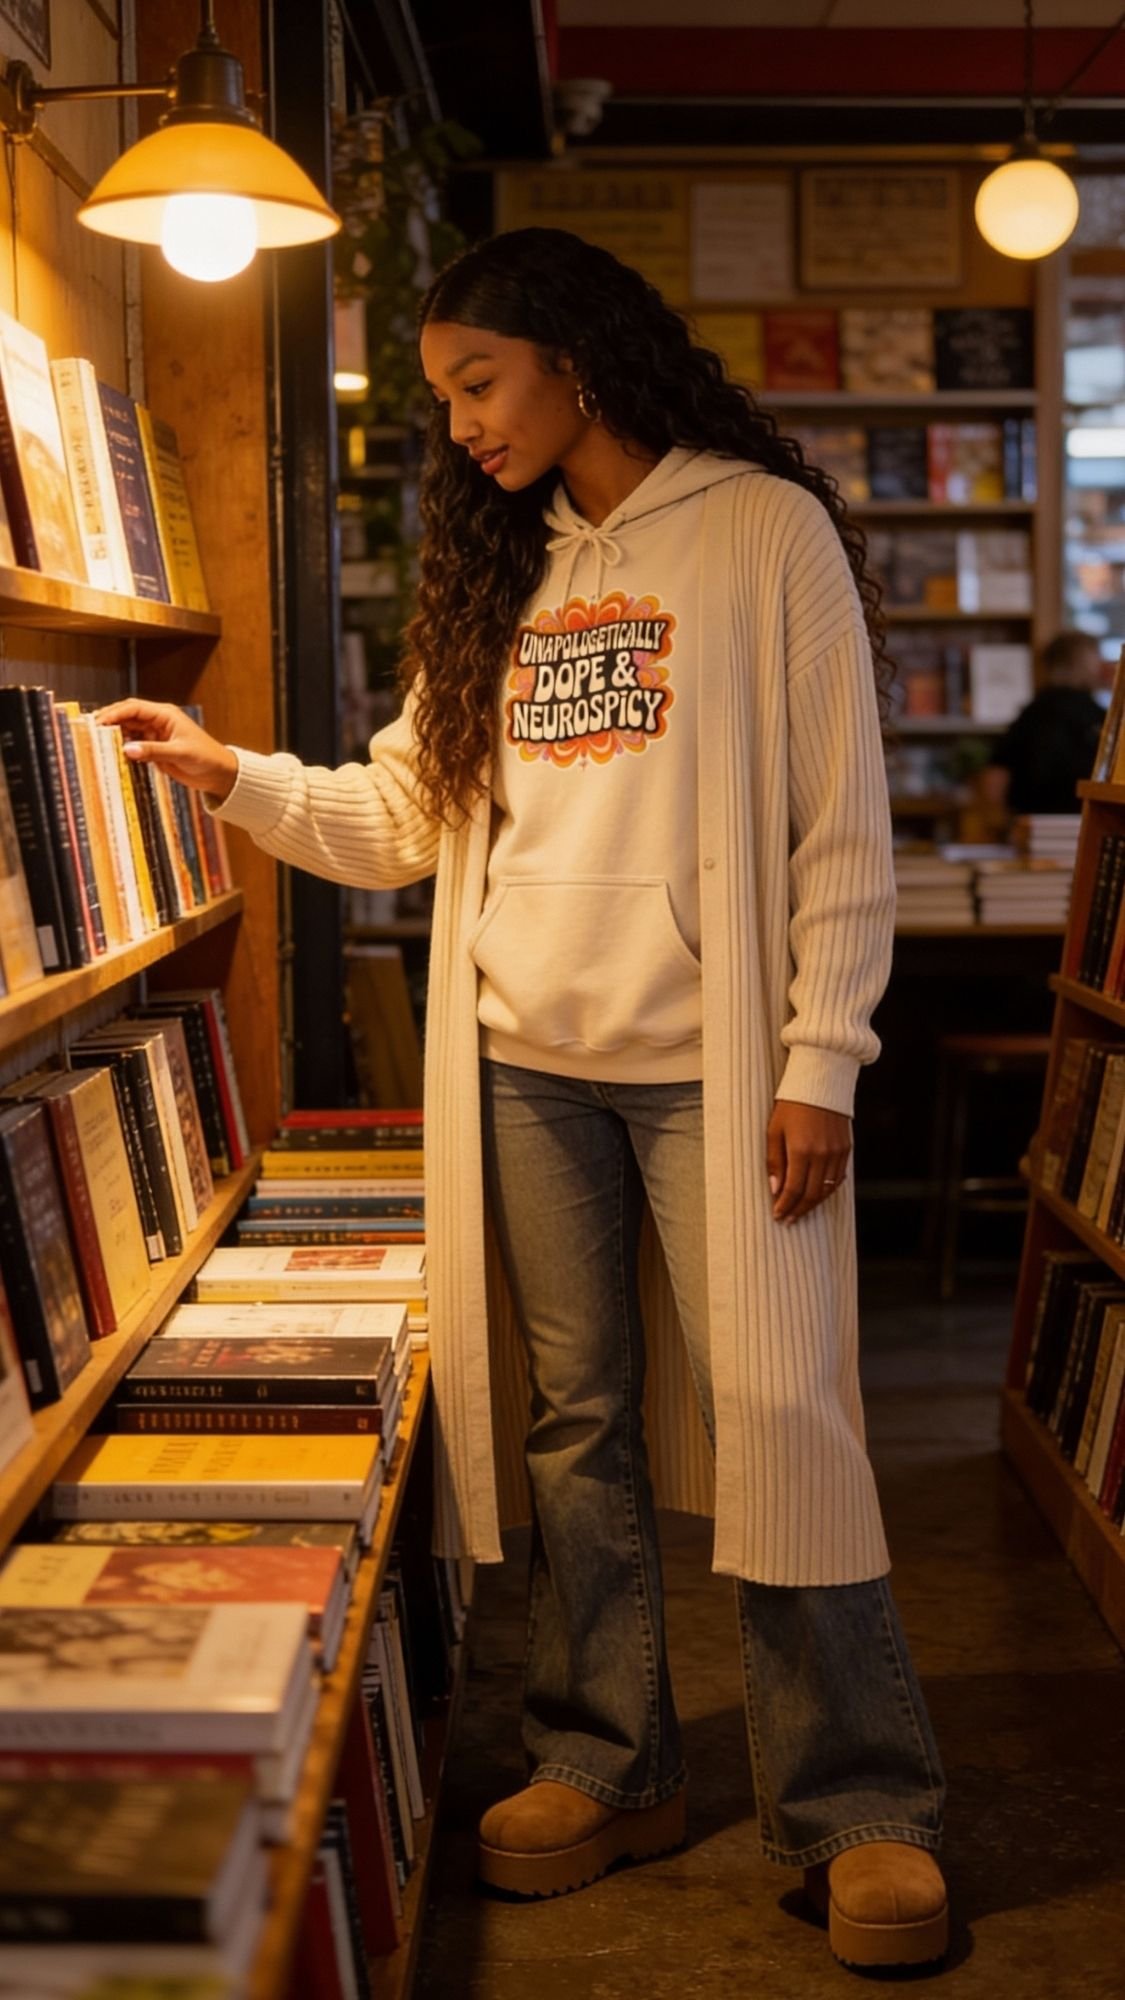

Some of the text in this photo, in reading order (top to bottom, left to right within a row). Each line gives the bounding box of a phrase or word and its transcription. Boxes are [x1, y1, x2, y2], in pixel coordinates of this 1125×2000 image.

[519, 621, 666, 665] UNAPOLOGETICALLY
[534, 651, 638, 703] DOPE &
